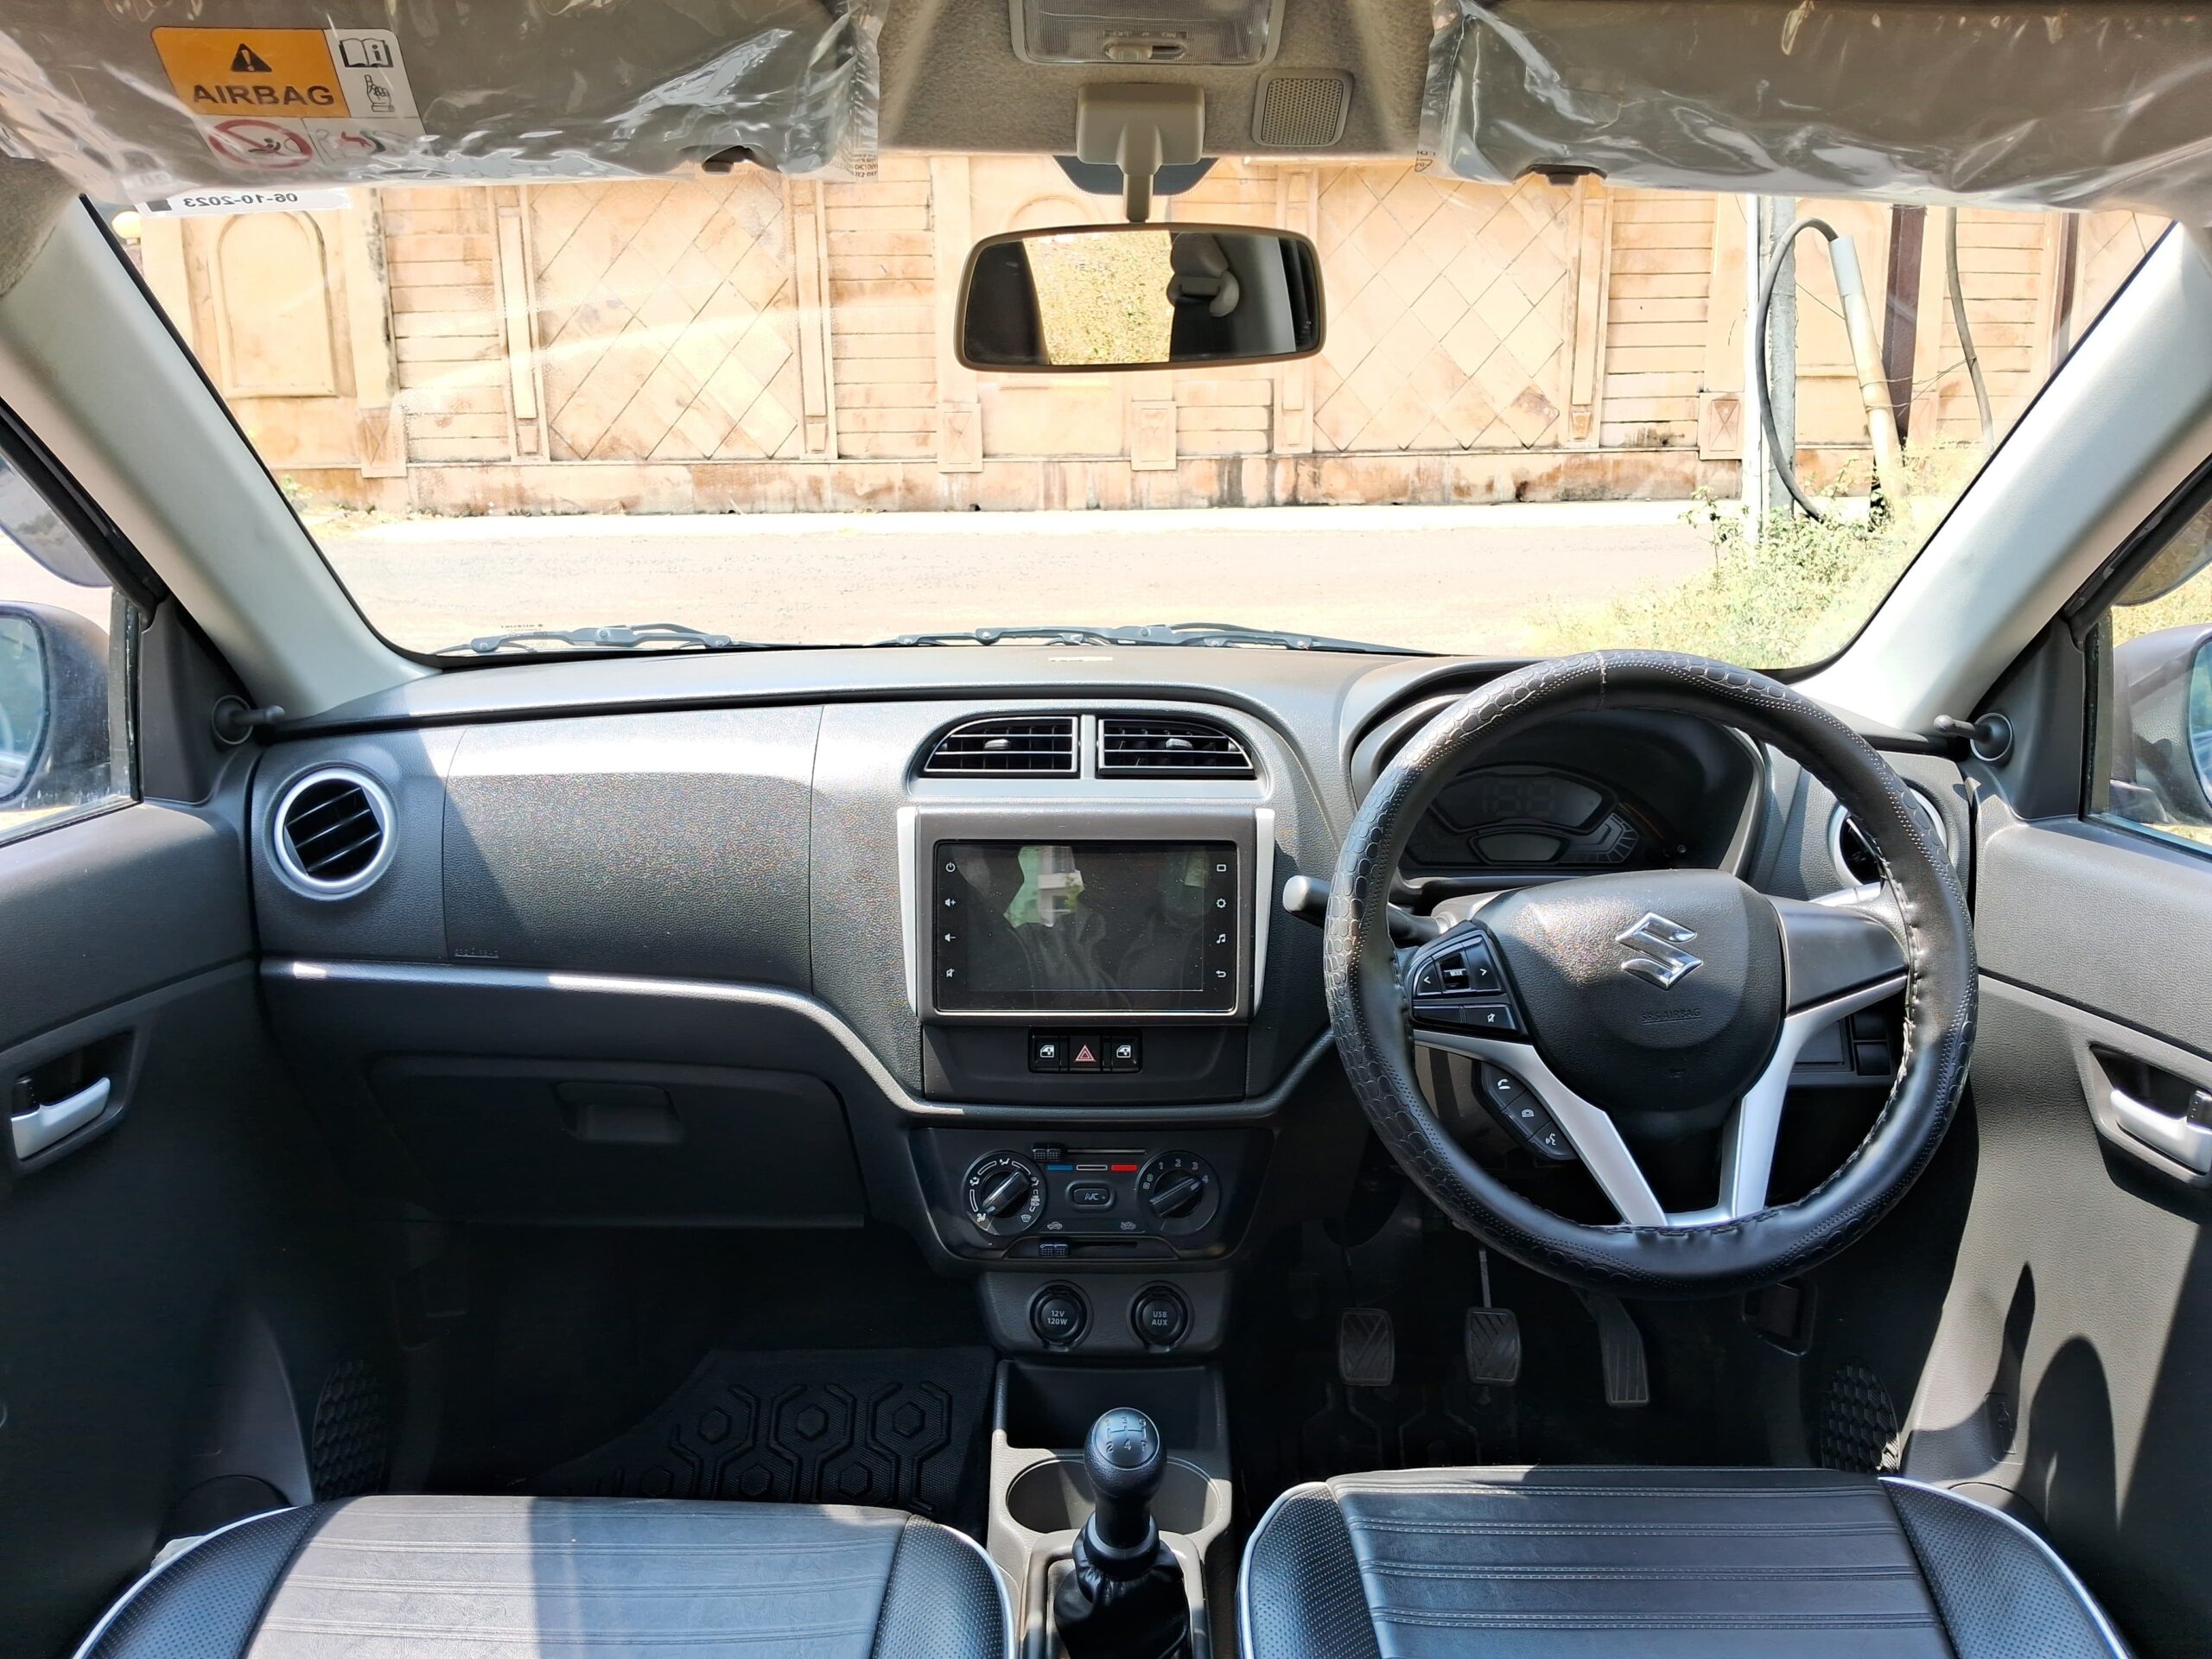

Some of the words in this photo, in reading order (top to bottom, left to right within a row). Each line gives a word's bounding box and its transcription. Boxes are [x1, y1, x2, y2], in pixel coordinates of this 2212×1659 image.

[193, 84, 335, 105] AIRBAG
[1662, 1007, 1701, 1020] AIRBAG
[1159, 1161, 1164, 1170] 1
[1175, 1159, 1181, 1167] 2
[1192, 1161, 1198, 1171] 3
[1202, 1174, 1209, 1184] 4
[1084, 1192, 1099, 1201] A/C
[1106, 1441, 1114, 1452] 2
[1123, 1439, 1132, 1451] 4
